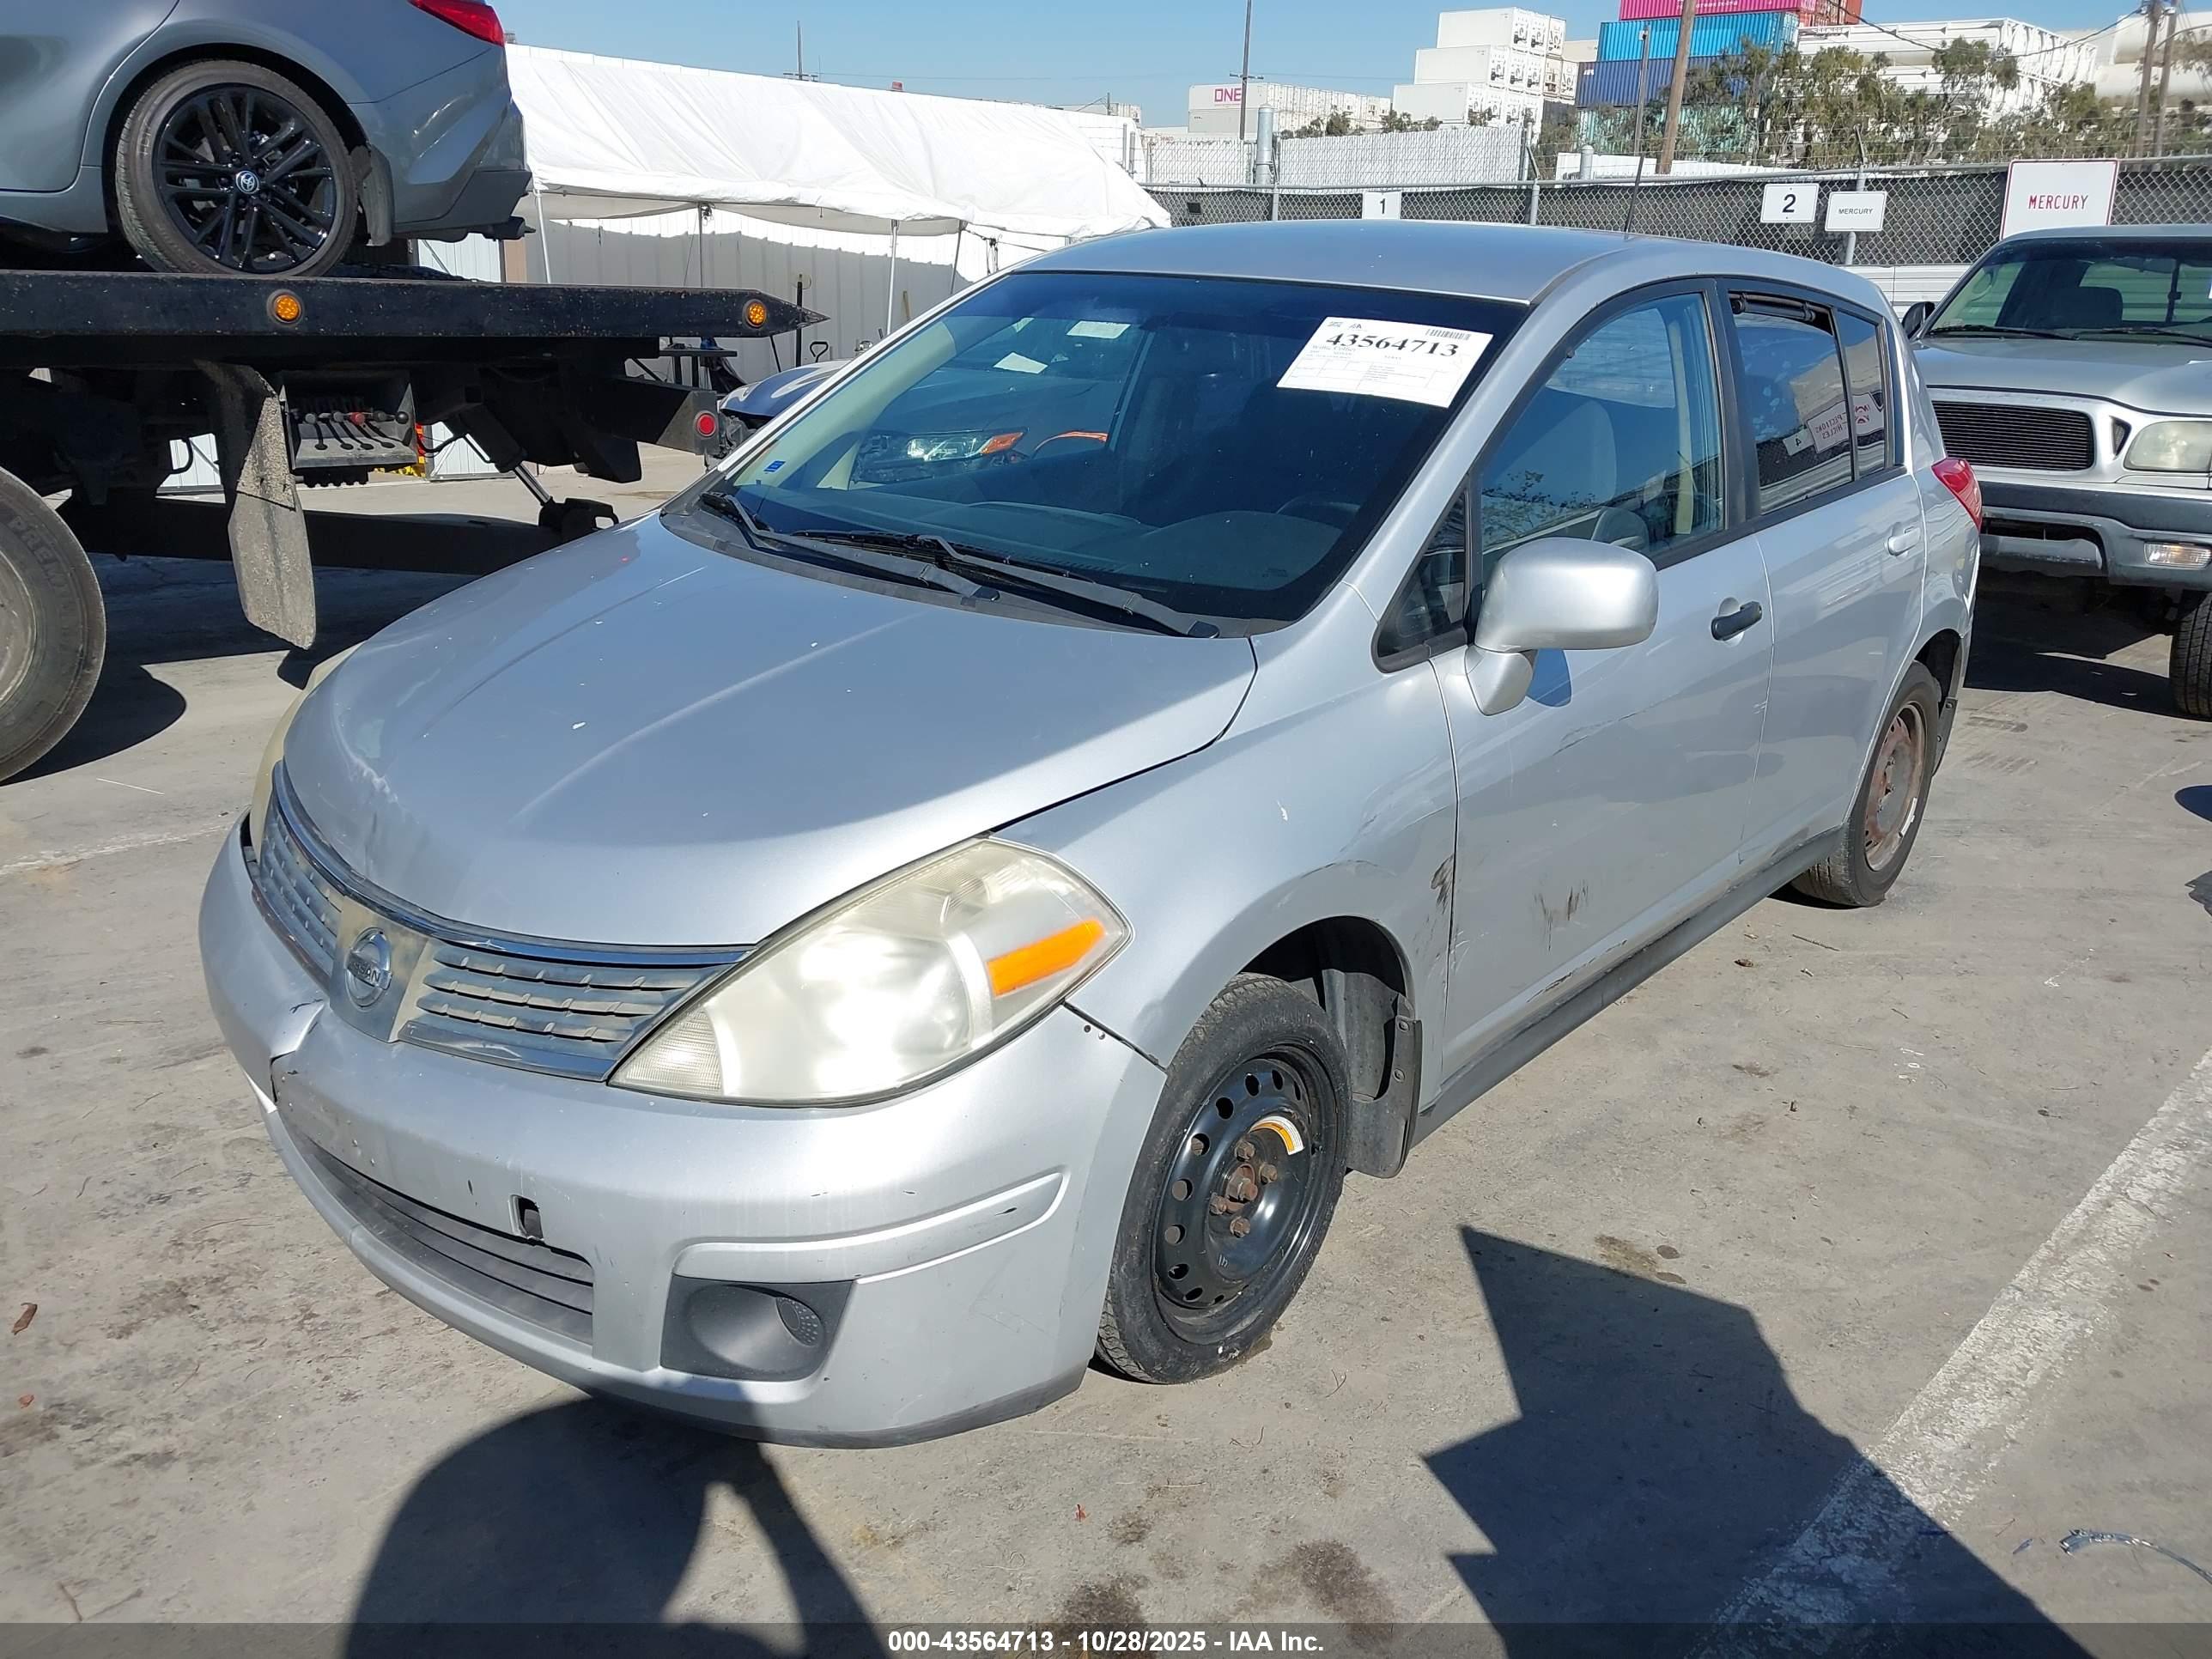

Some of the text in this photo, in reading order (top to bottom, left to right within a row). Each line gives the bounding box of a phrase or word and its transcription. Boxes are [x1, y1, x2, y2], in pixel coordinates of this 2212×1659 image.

[1214, 88, 1242, 102] ONE
[1379, 198, 1387, 215] 1
[1782, 193, 1797, 213] 2
[2028, 194, 2089, 210] MERCURY
[1325, 332, 1460, 357] 43564713
